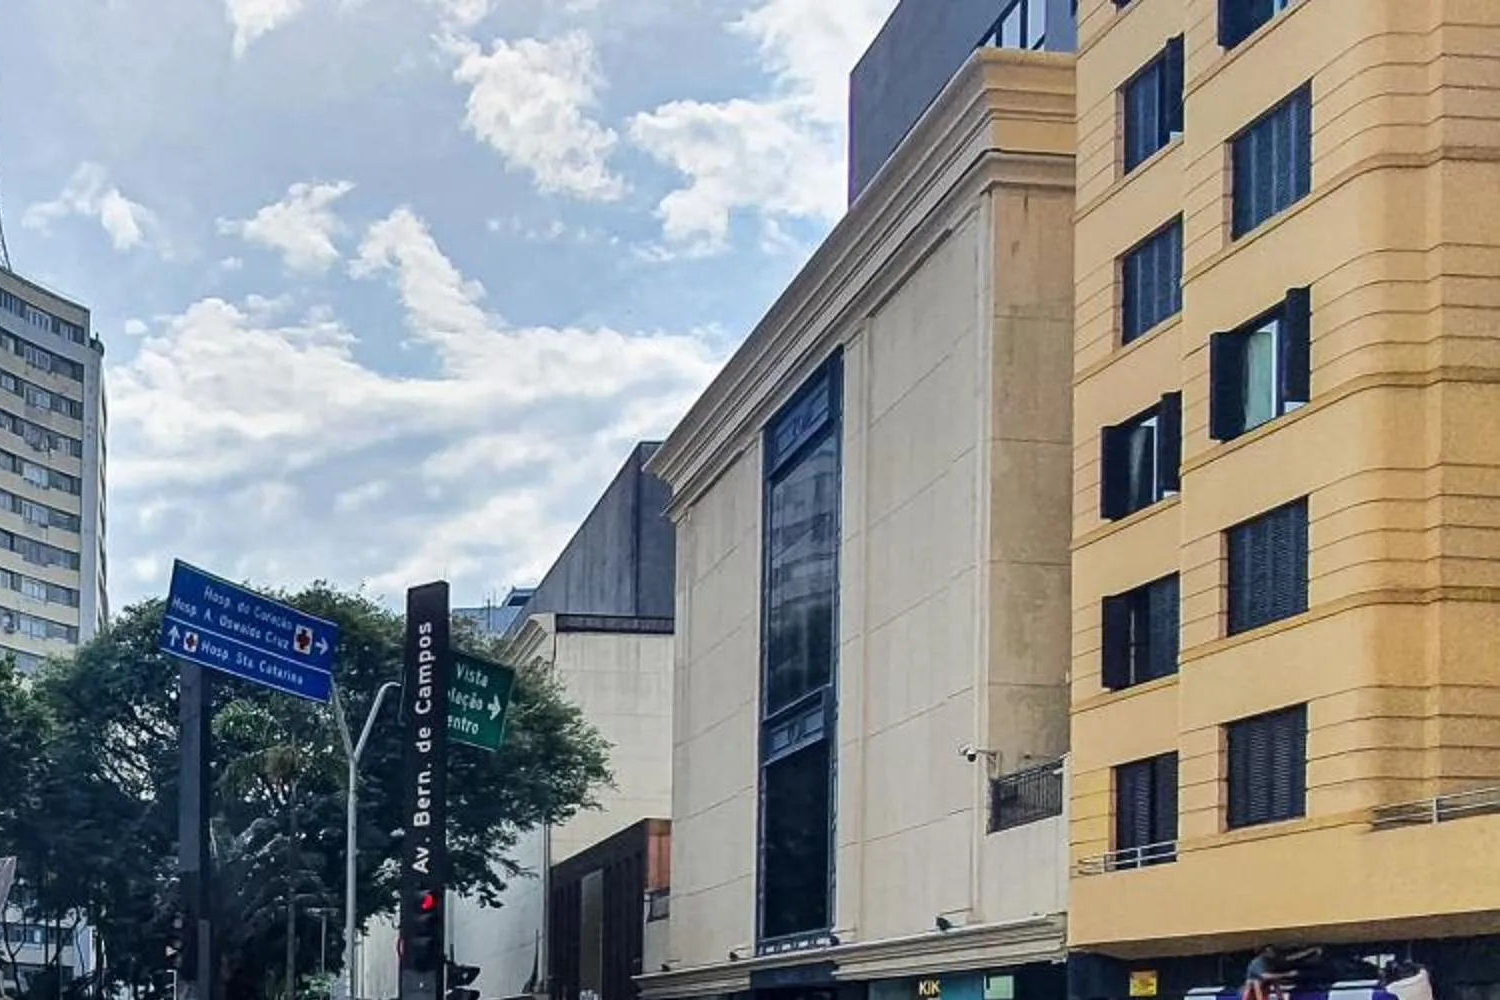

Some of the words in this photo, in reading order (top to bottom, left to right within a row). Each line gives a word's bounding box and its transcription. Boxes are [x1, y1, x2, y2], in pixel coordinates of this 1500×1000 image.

[265, 631, 290, 650] Cruz
[414, 621, 436, 715] Campos
[456, 662, 489, 688] Vista
[447, 714, 480, 735] entro
[415, 726, 432, 753] de
[413, 763, 432, 827] Bern.
[411, 836, 430, 874] Av.
[919, 979, 941, 996] KIK
